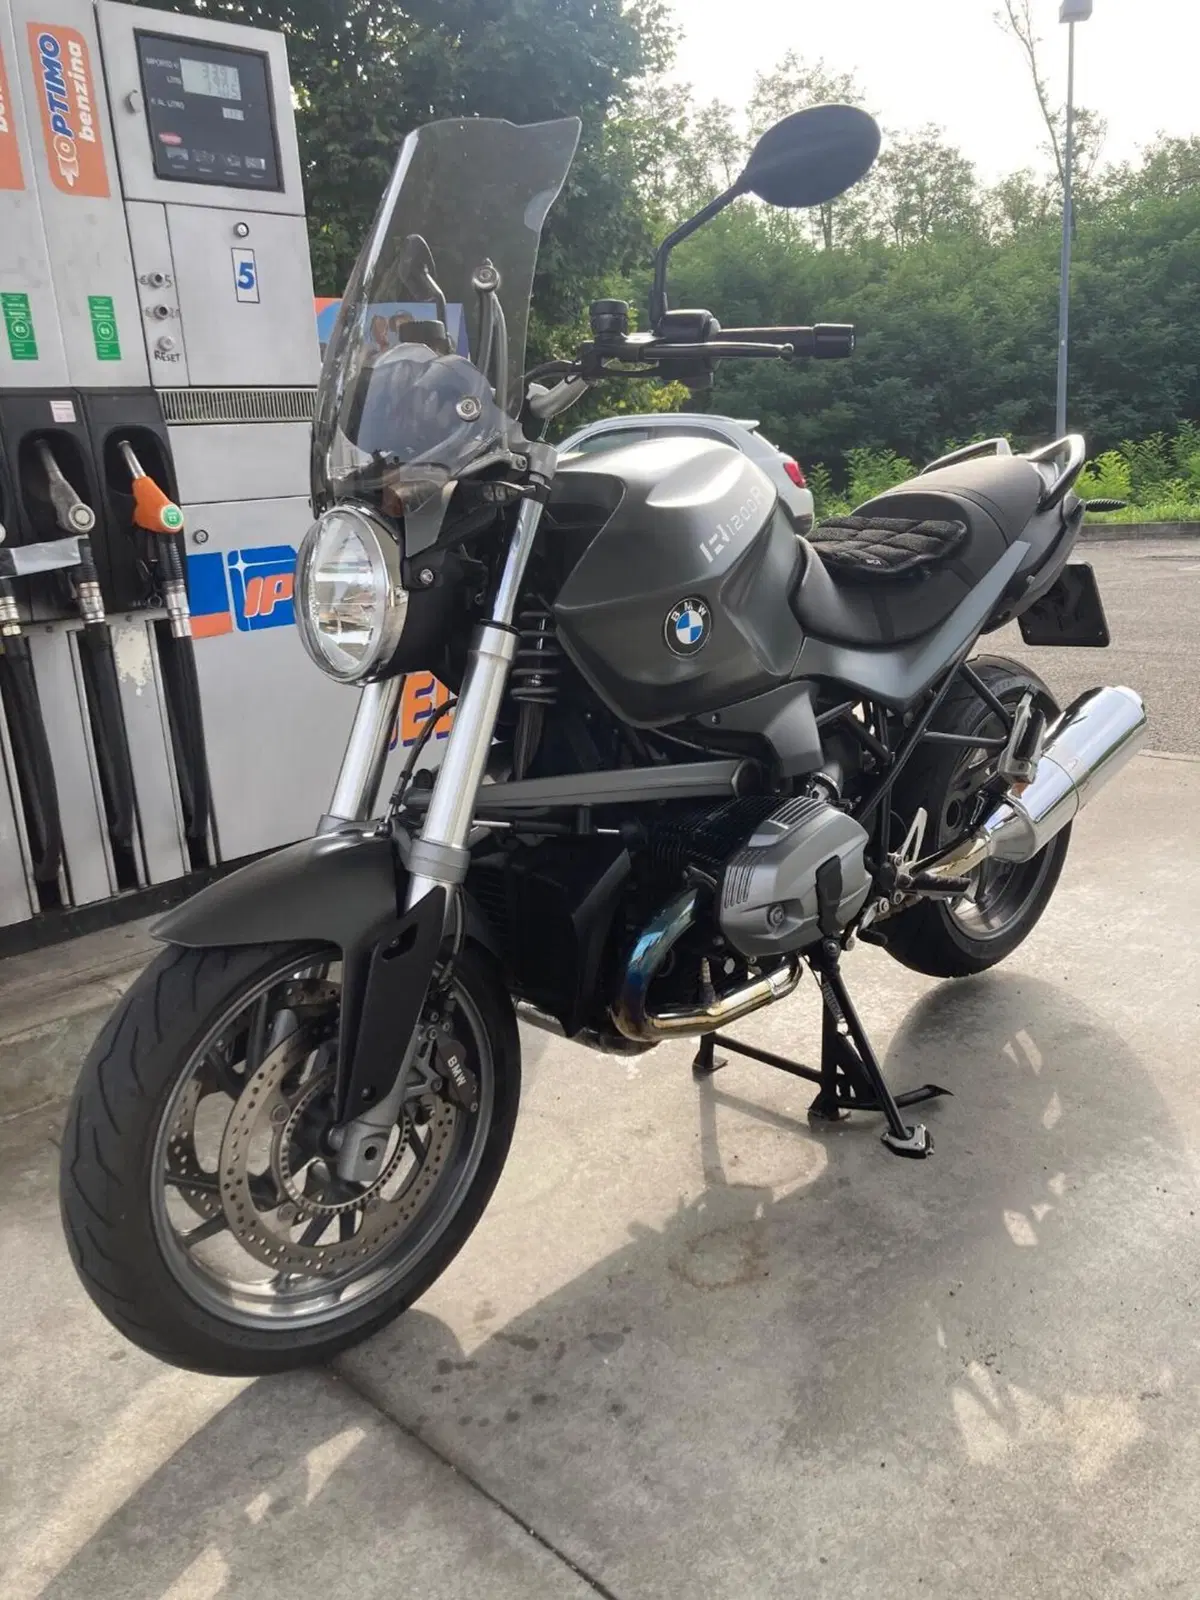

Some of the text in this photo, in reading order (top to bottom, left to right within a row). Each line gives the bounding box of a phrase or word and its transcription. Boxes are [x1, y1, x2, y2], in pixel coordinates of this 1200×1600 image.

[68, 40, 96, 142] benzina
[236, 261, 256, 290] 5
[154, 350, 181, 363] RESET
[671, 601, 707, 622] BMW
[447, 1055, 467, 1087] BMW
